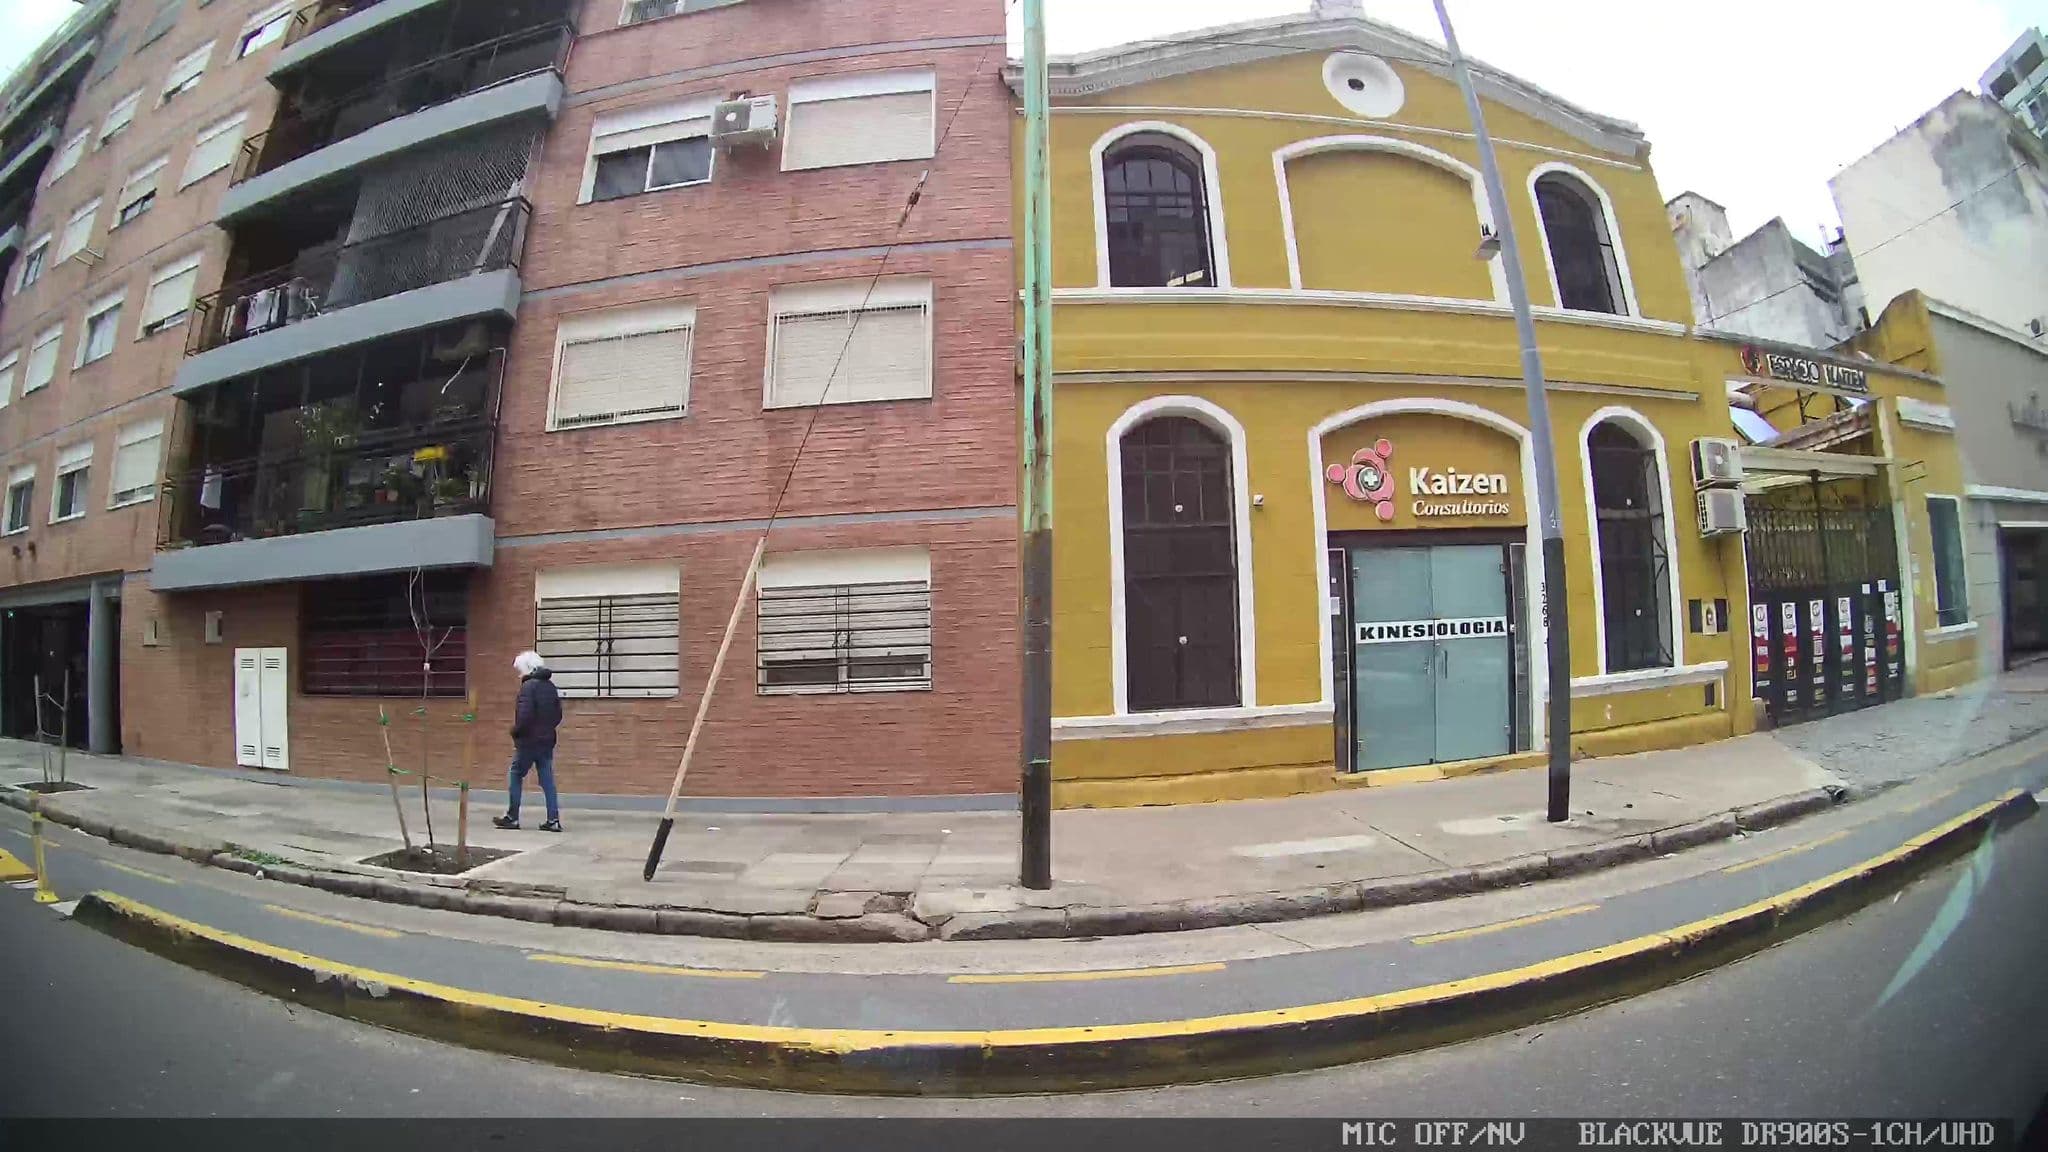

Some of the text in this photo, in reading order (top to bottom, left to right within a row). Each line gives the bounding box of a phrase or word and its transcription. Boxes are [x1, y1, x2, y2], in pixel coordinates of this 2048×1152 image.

[1409, 466, 1508, 495] Kaizen
[1413, 499, 1509, 516] Consultorios
[1360, 620, 1506, 641] KINESIOLOGIA
